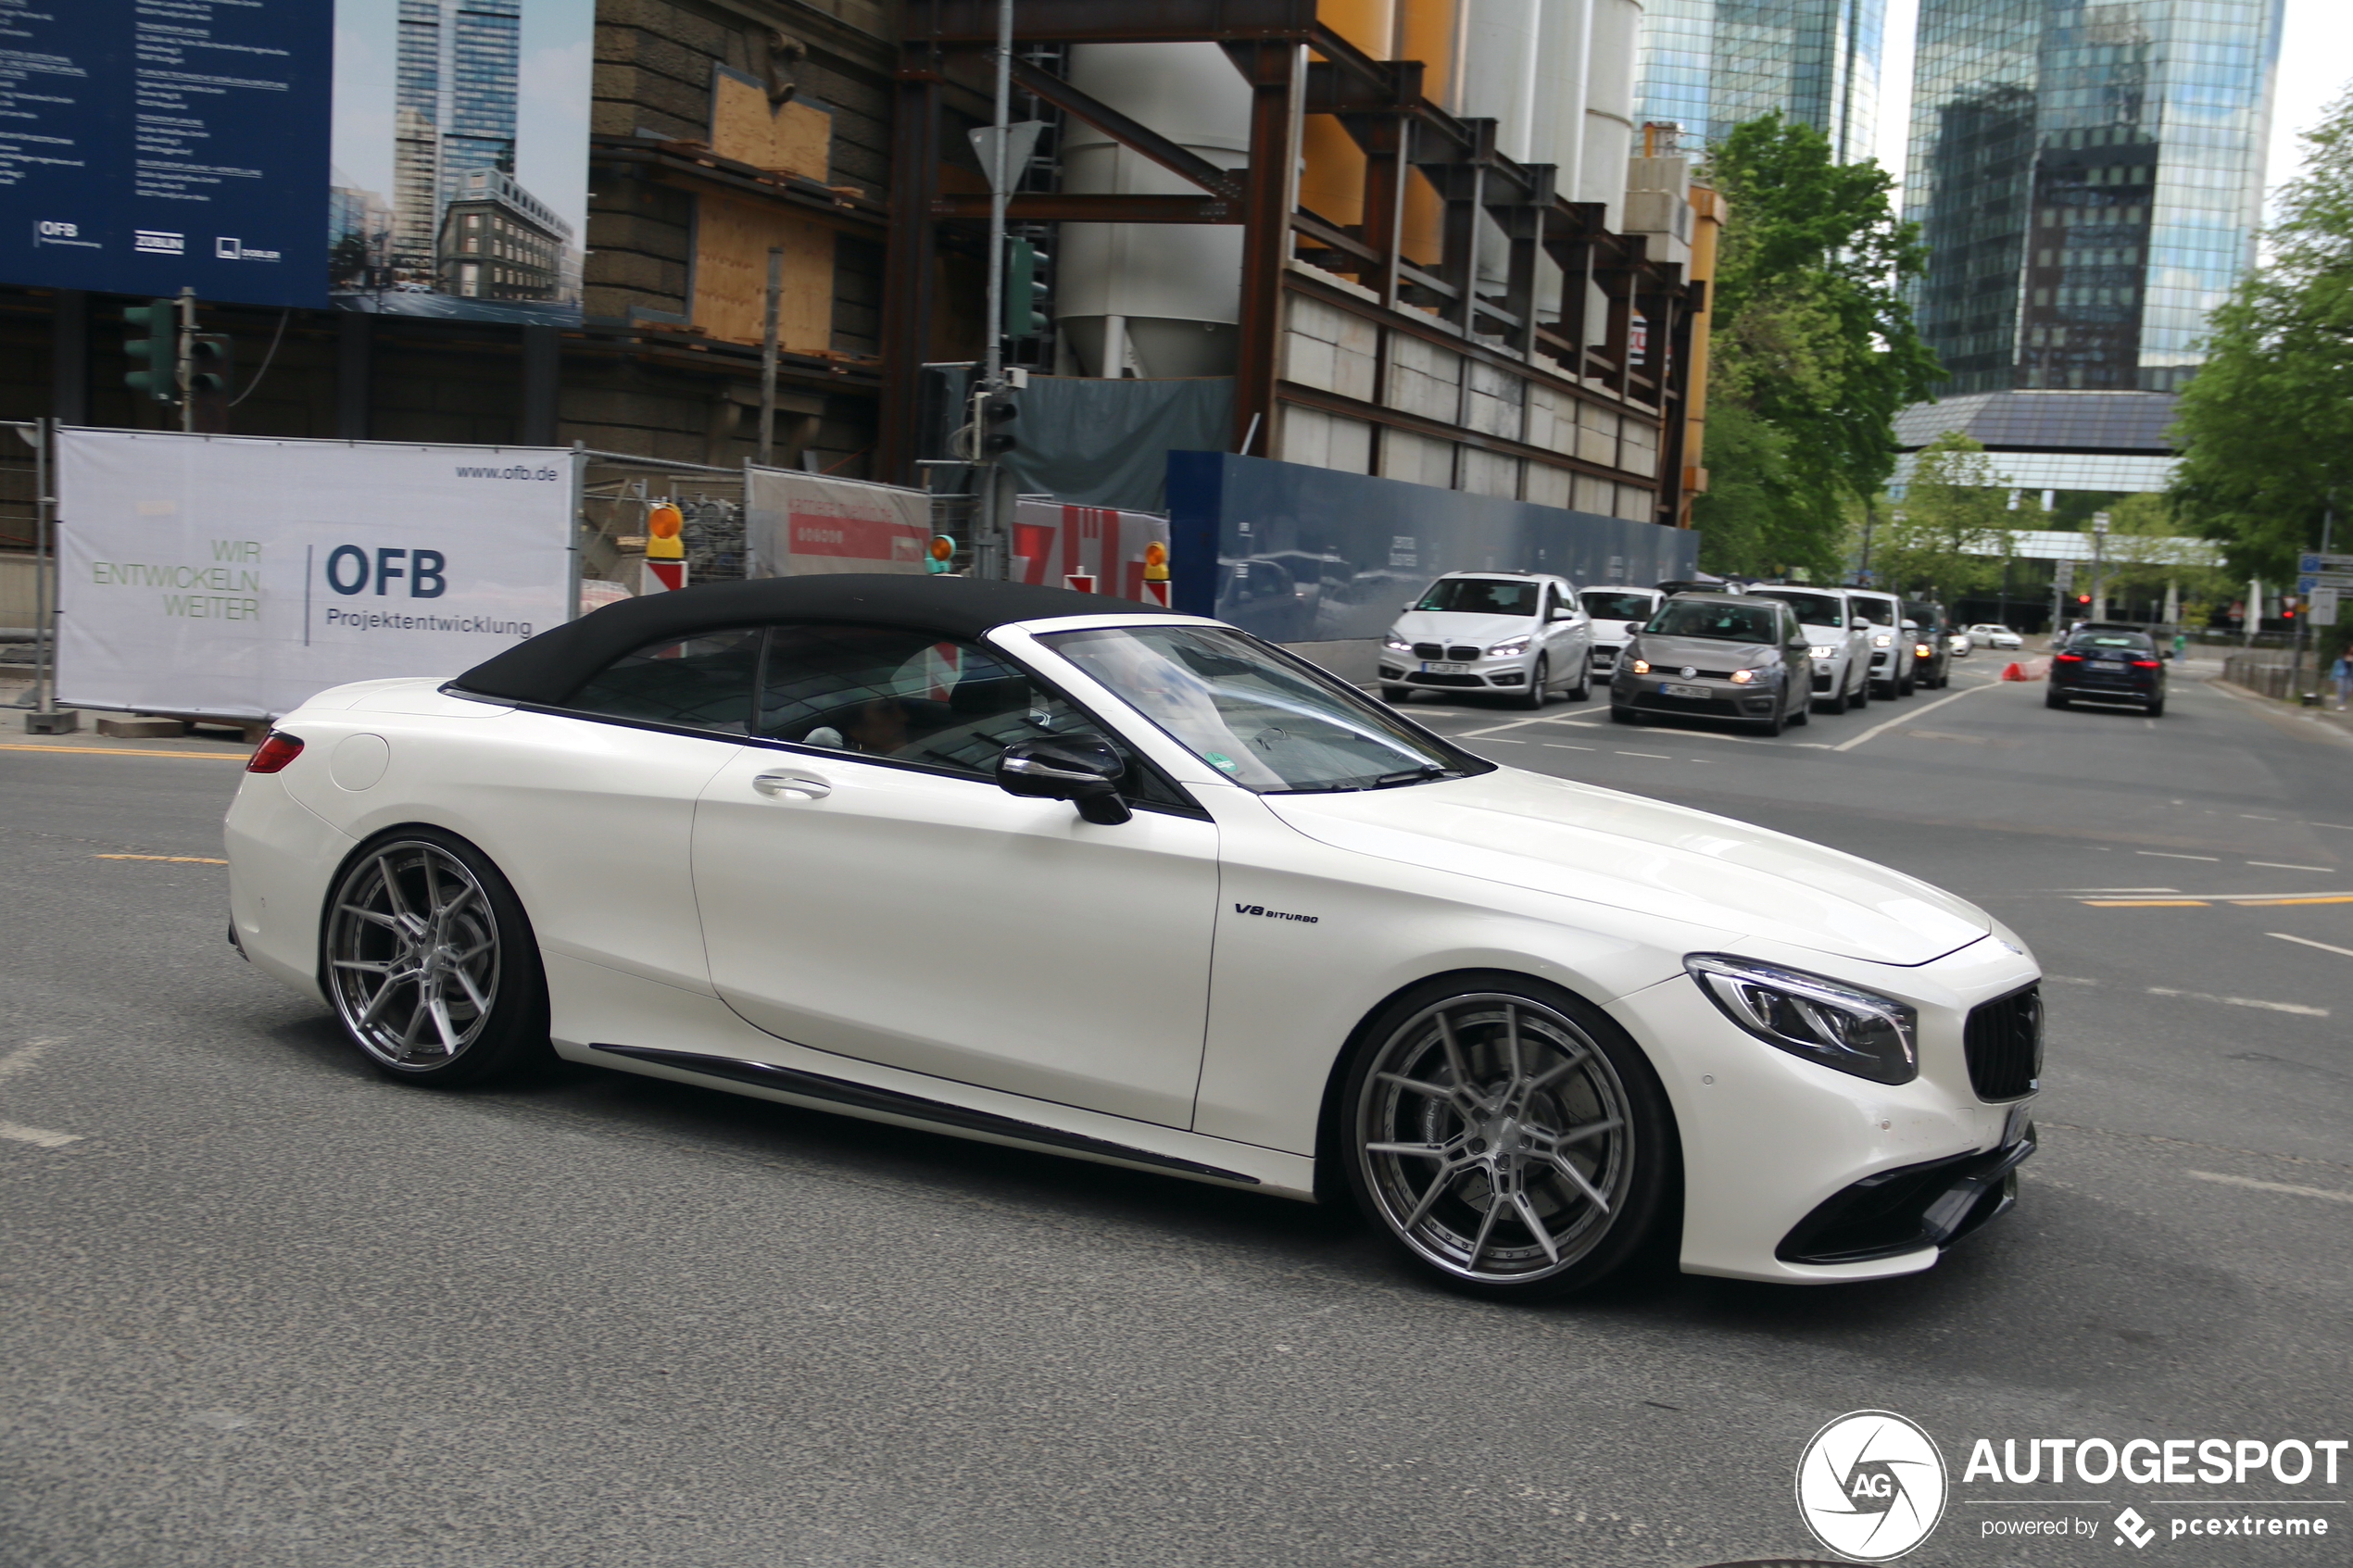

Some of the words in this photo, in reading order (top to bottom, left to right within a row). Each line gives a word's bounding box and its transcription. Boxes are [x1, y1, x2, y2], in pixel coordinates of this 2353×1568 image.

[39, 220, 79, 237] OFB
[456, 465, 559, 482] www.ofb.de
[210, 540, 261, 563] WIR
[93, 561, 260, 593] ENTWICKELN
[327, 544, 447, 599] OFB
[162, 594, 260, 621] WEITER
[326, 608, 533, 639] Projektentwicklung
[1235, 903, 1265, 916] V8
[1265, 911, 1318, 923] BITURBO
